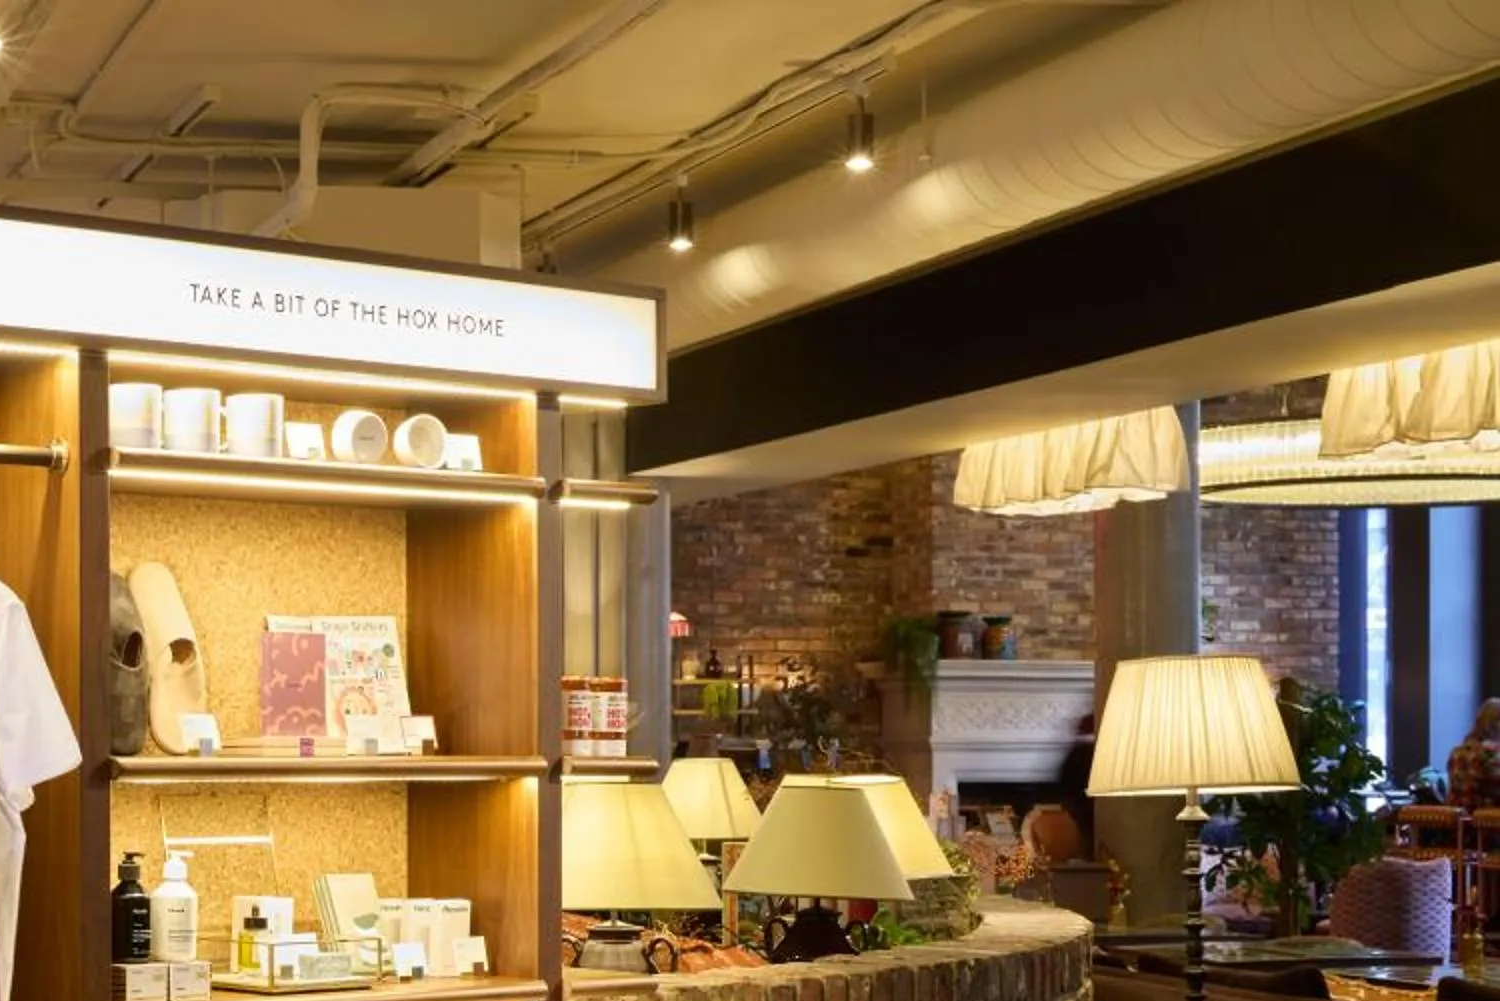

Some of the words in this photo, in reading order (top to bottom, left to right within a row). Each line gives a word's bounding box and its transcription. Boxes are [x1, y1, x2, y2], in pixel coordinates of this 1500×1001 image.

[189, 283, 241, 309] TAKE
[251, 291, 266, 311] A
[274, 293, 305, 314] BIT
[314, 297, 341, 319] OF
[350, 301, 387, 326] THE
[397, 307, 438, 330] HOX
[447, 313, 505, 338] HOME
